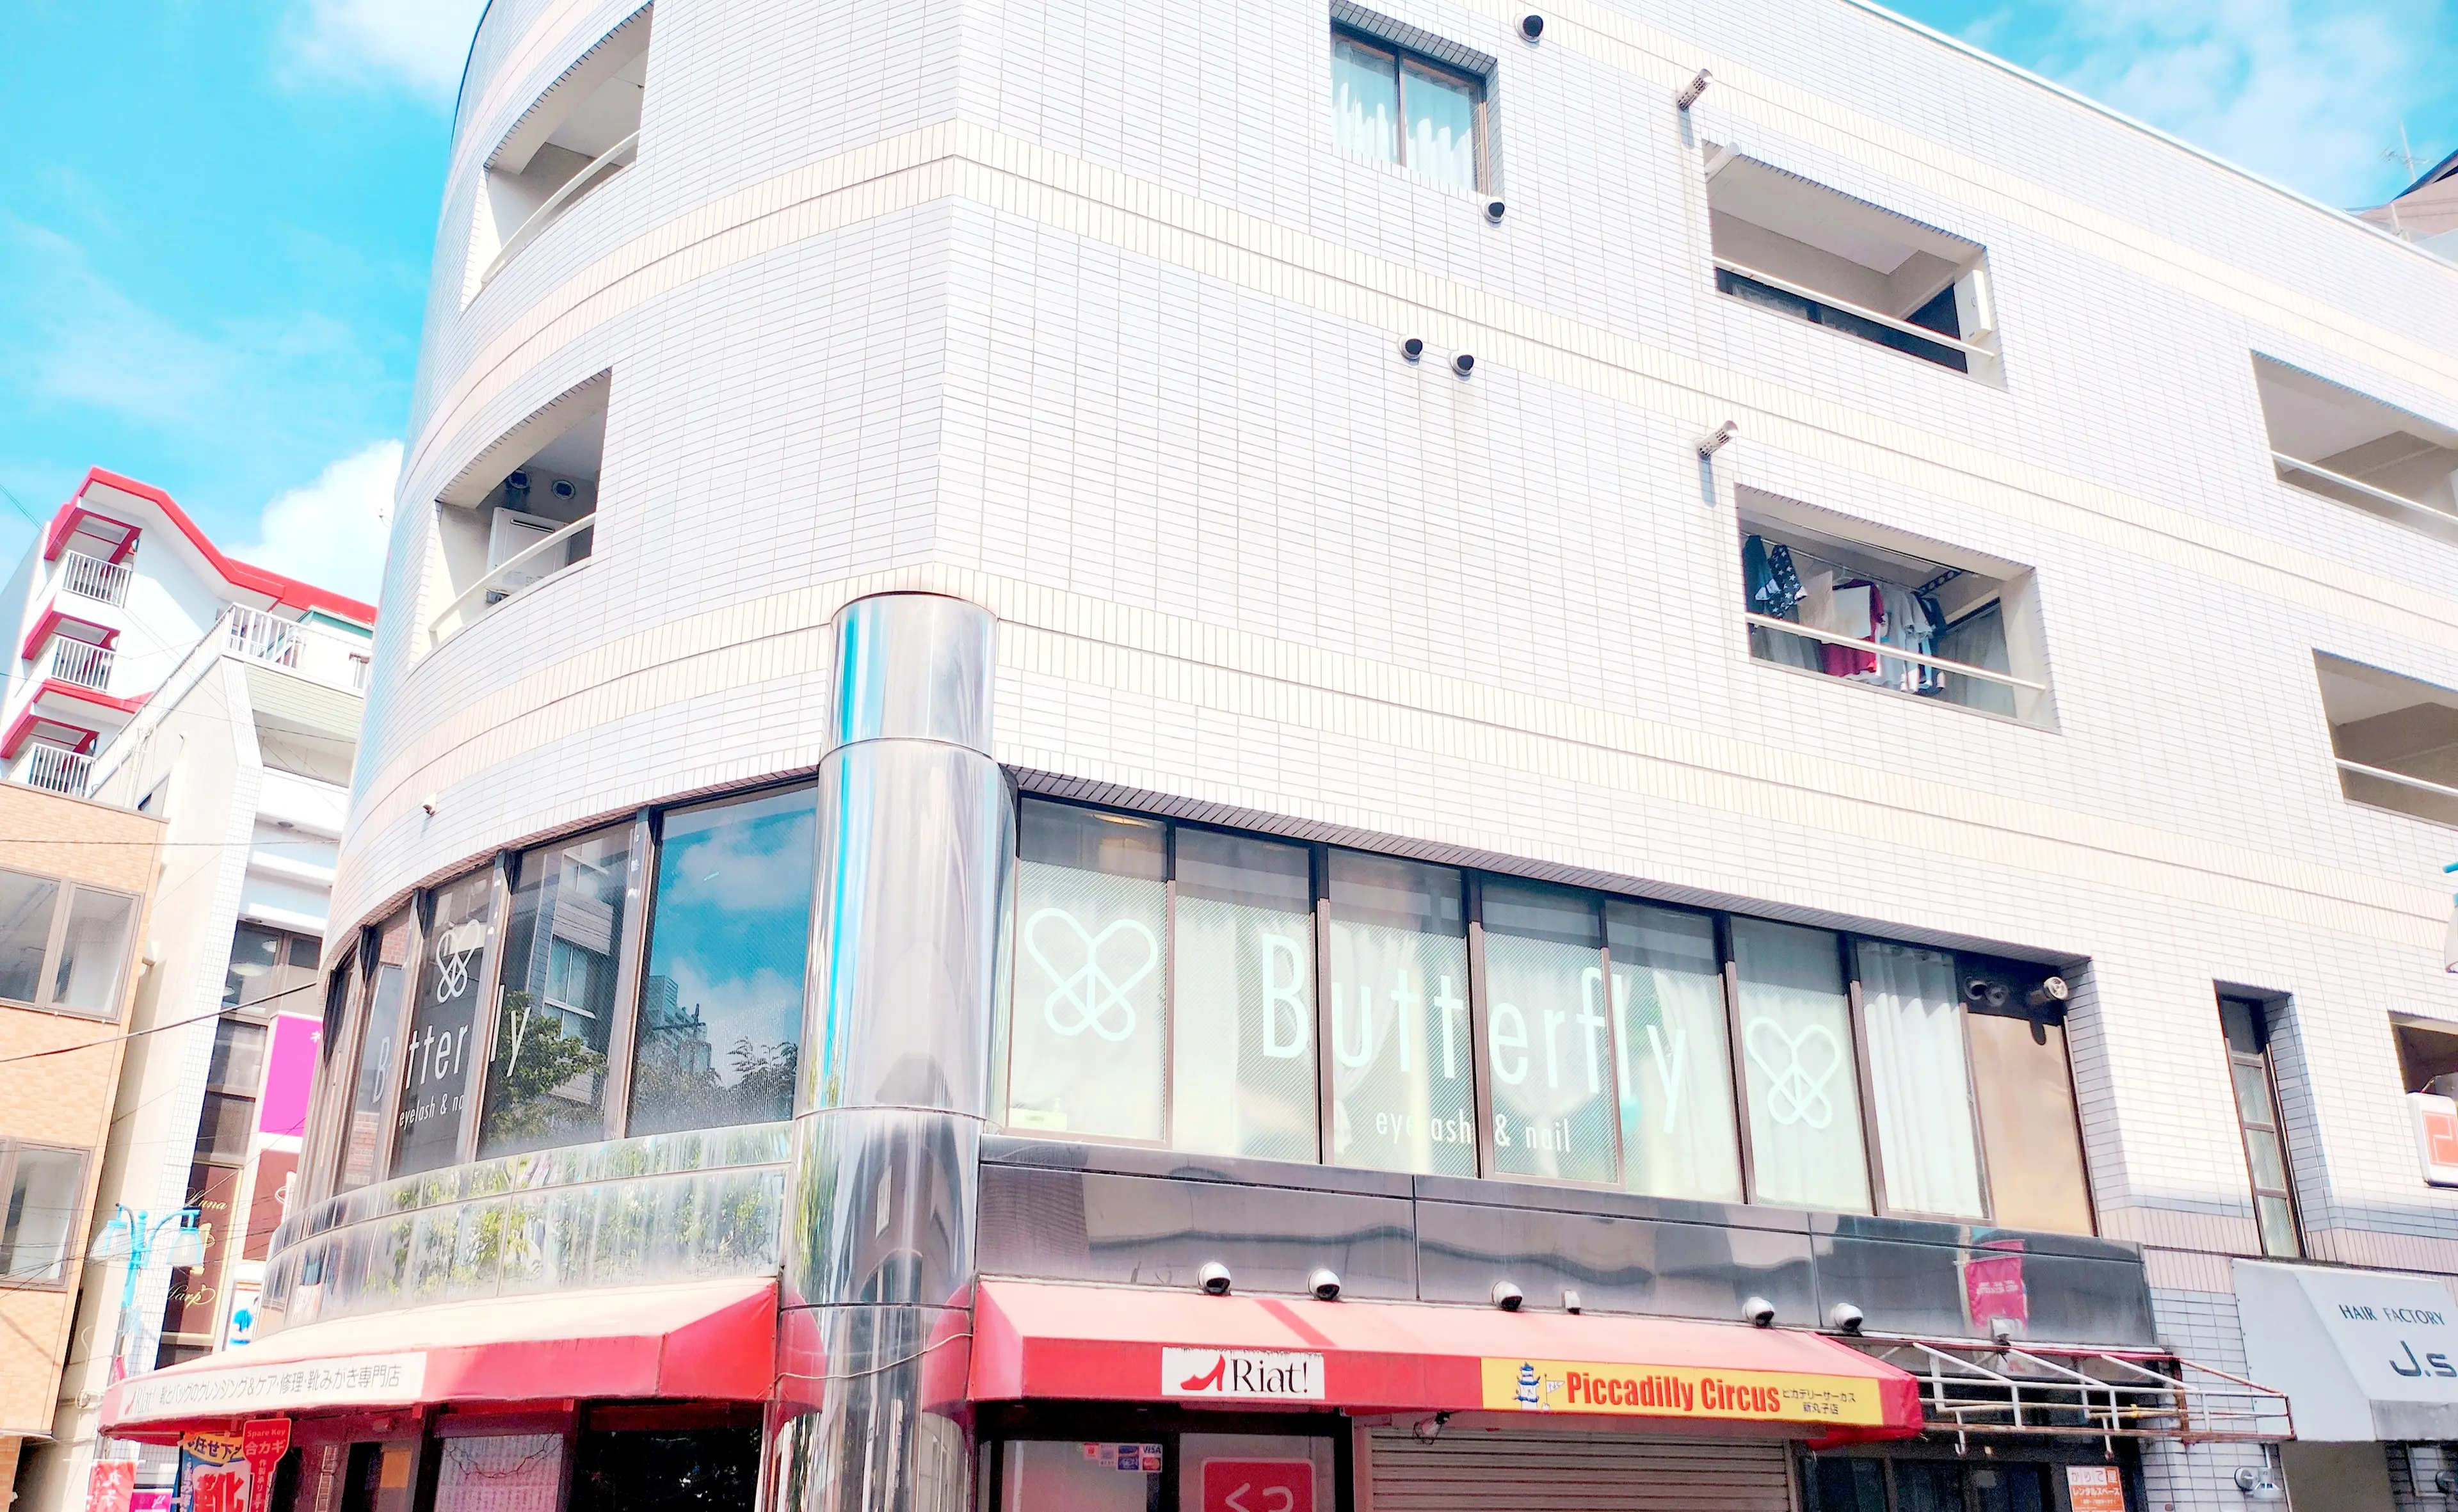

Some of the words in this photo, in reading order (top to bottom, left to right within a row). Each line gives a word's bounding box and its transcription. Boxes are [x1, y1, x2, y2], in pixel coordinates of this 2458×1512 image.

[373, 983, 531, 1104] Btterly
[1261, 933, 1687, 1134] Butterfly
[399, 1095, 436, 1131] eyelash
[440, 1093, 448, 1116] &
[1495, 1113, 1511, 1146] &
[1525, 1118, 1571, 1152] nail
[2339, 1304, 2378, 1321] HAIR
[2382, 1307, 2445, 1326] FACTORY
[1230, 1358, 1308, 1394] Riat!
[1566, 1371, 1693, 1411] Piccadilly
[1700, 1377, 1780, 1413] Circus
[245, 1439, 287, 1456] 合カギ
[247, 1429, 269, 1439] Spare
[271, 1428, 286, 1437] Key
[1143, 1445, 1161, 1454] VISA
